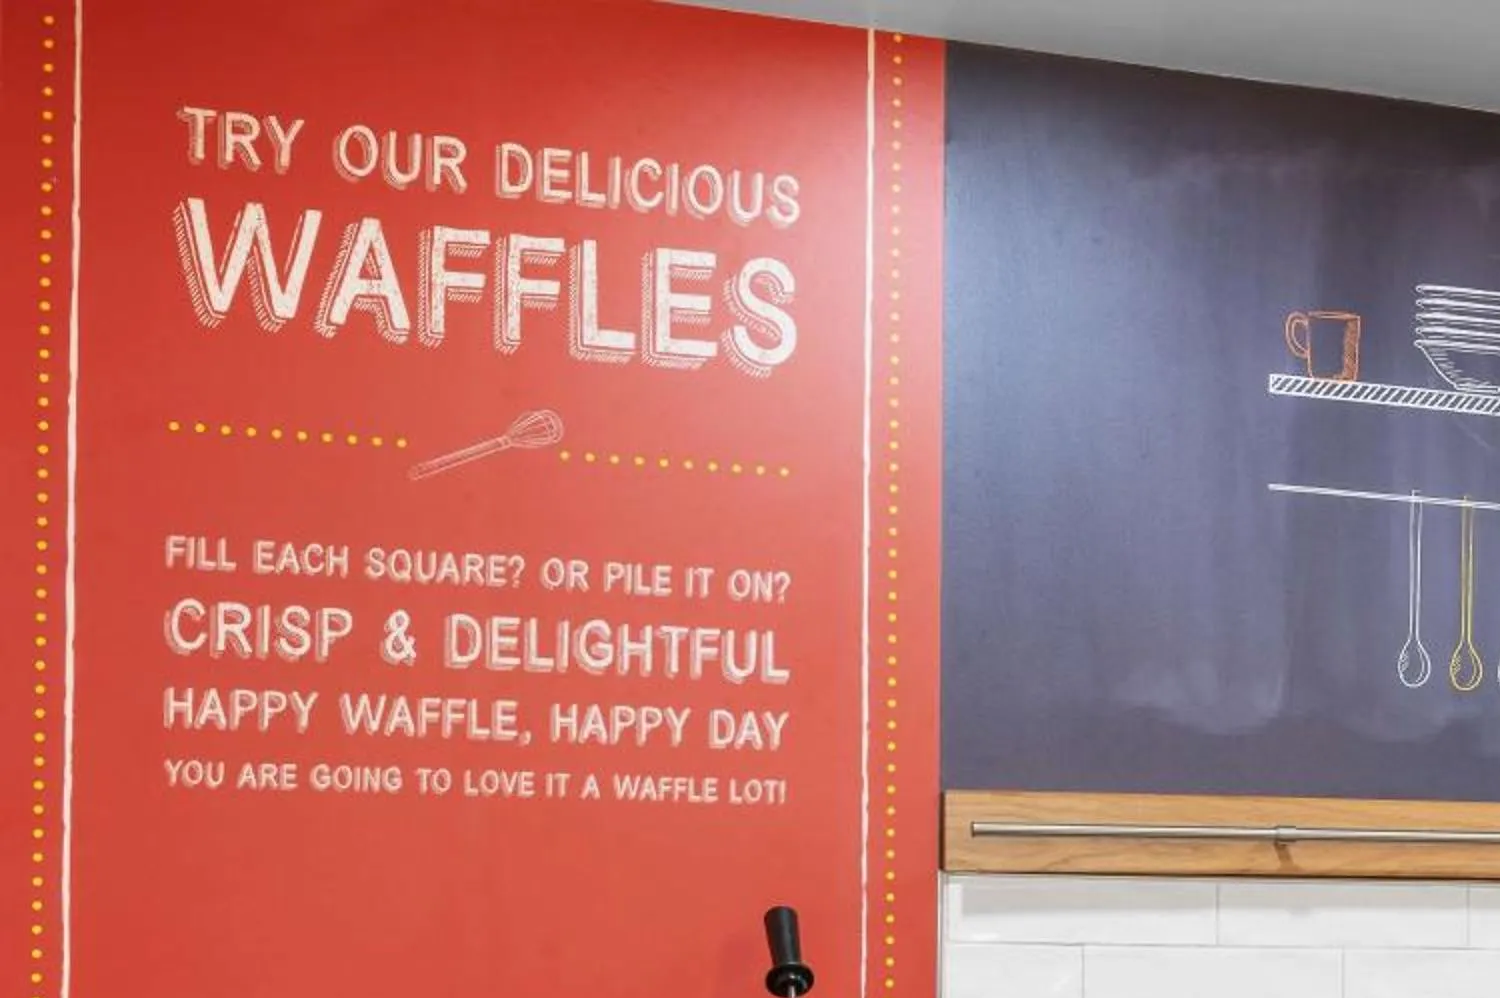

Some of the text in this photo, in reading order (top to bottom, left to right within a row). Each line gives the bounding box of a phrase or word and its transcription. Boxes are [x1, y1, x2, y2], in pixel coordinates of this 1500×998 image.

[178, 107, 801, 227] TRY OUR DELICIOUS
[174, 198, 797, 377] WAFFLES
[165, 536, 791, 604] FILL EACH SQUARE? OR PILE IT ON?
[165, 598, 791, 684] CRISP & DELIGHTFUL
[164, 687, 789, 750] HAPPY WAFFLE, HAPPY DAY
[164, 759, 787, 805] YOU ARE GOING TO LOVE IT A WAFFLE LOT!
